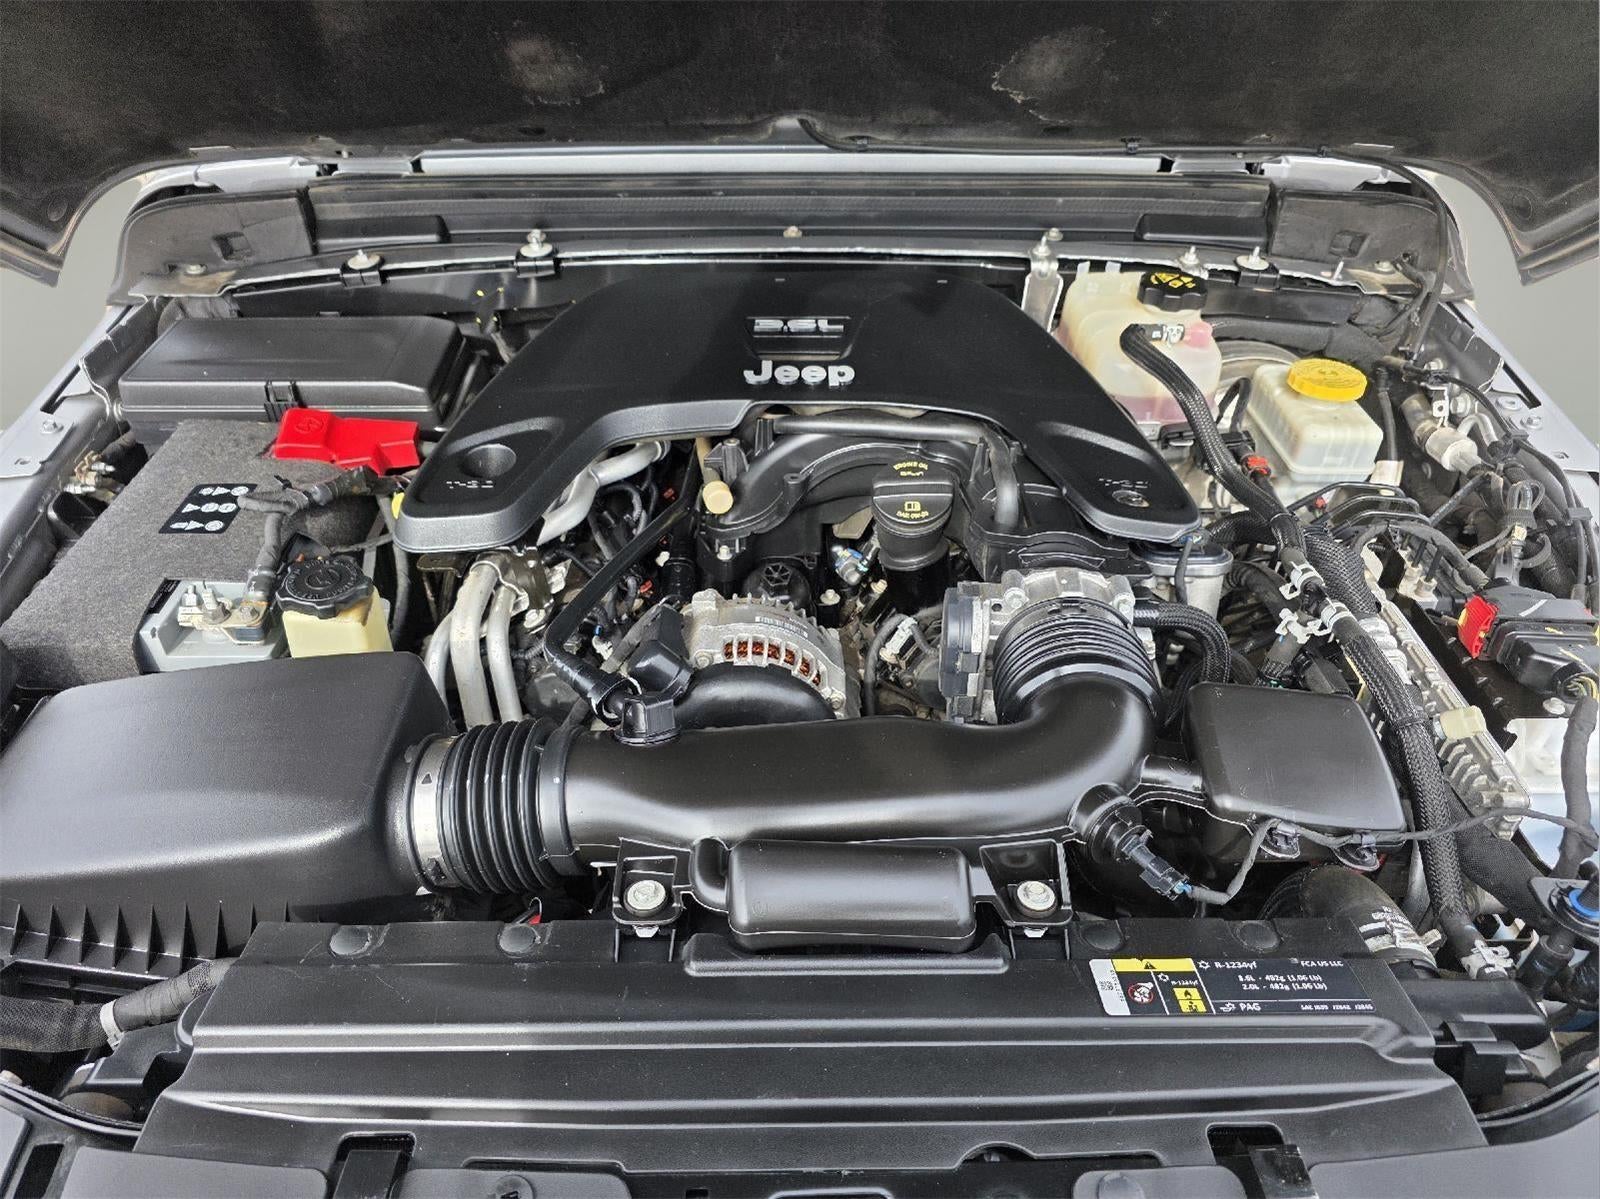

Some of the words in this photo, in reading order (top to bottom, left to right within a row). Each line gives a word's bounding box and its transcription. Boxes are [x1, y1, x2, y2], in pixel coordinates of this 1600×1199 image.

[743, 360, 855, 387] Jeep
[893, 461, 918, 471] ENGINE
[918, 462, 929, 471] OIL
[1239, 1002, 1261, 1011] PAG
